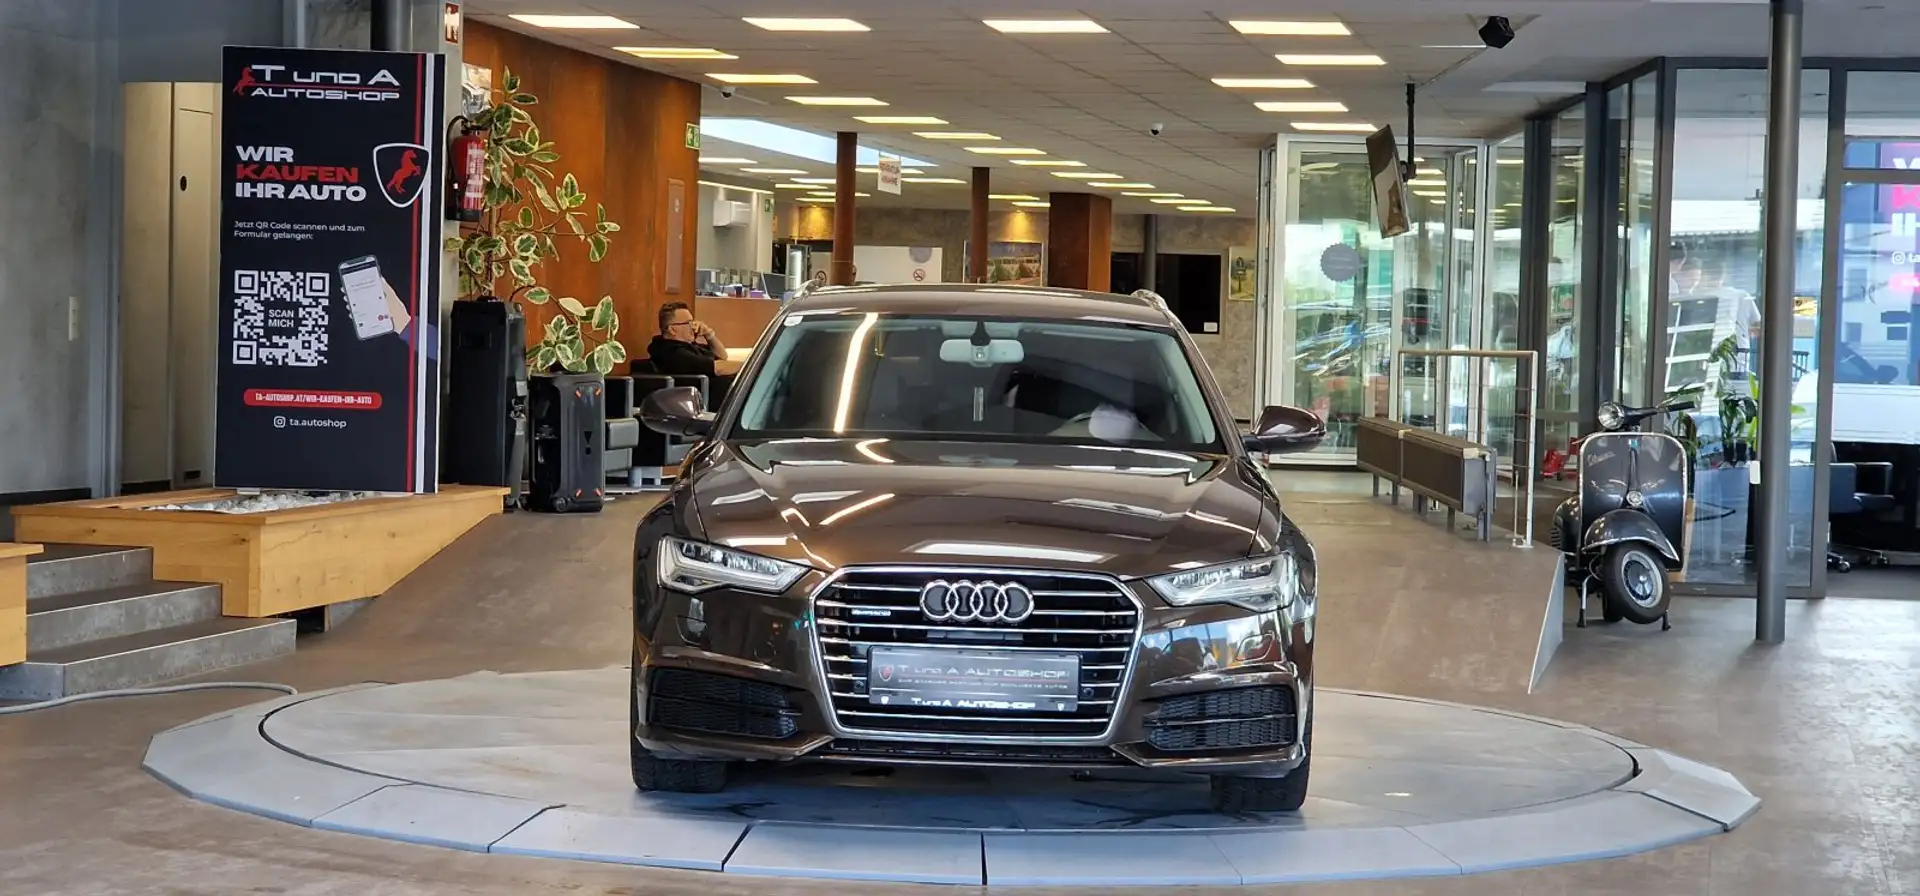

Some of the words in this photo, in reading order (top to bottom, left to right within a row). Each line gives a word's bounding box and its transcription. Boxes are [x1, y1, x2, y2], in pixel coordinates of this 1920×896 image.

[251, 64, 285, 81] T
[367, 69, 400, 87] A
[251, 87, 400, 101] AUTOSHOP
[236, 145, 294, 162] WIR
[236, 164, 359, 183] KAUFEN
[235, 182, 285, 199] IHR
[288, 185, 367, 202] AUTO
[234, 220, 254, 228] Jetzt
[255, 221, 269, 229] QR
[270, 222, 292, 230] Code
[293, 223, 328, 231] scannen
[329, 224, 345, 232] und
[234, 230, 271, 238] Formular
[268, 309, 294, 319] SCAN
[268, 319, 294, 328] MICH
[289, 418, 347, 429] ta.autoshop
